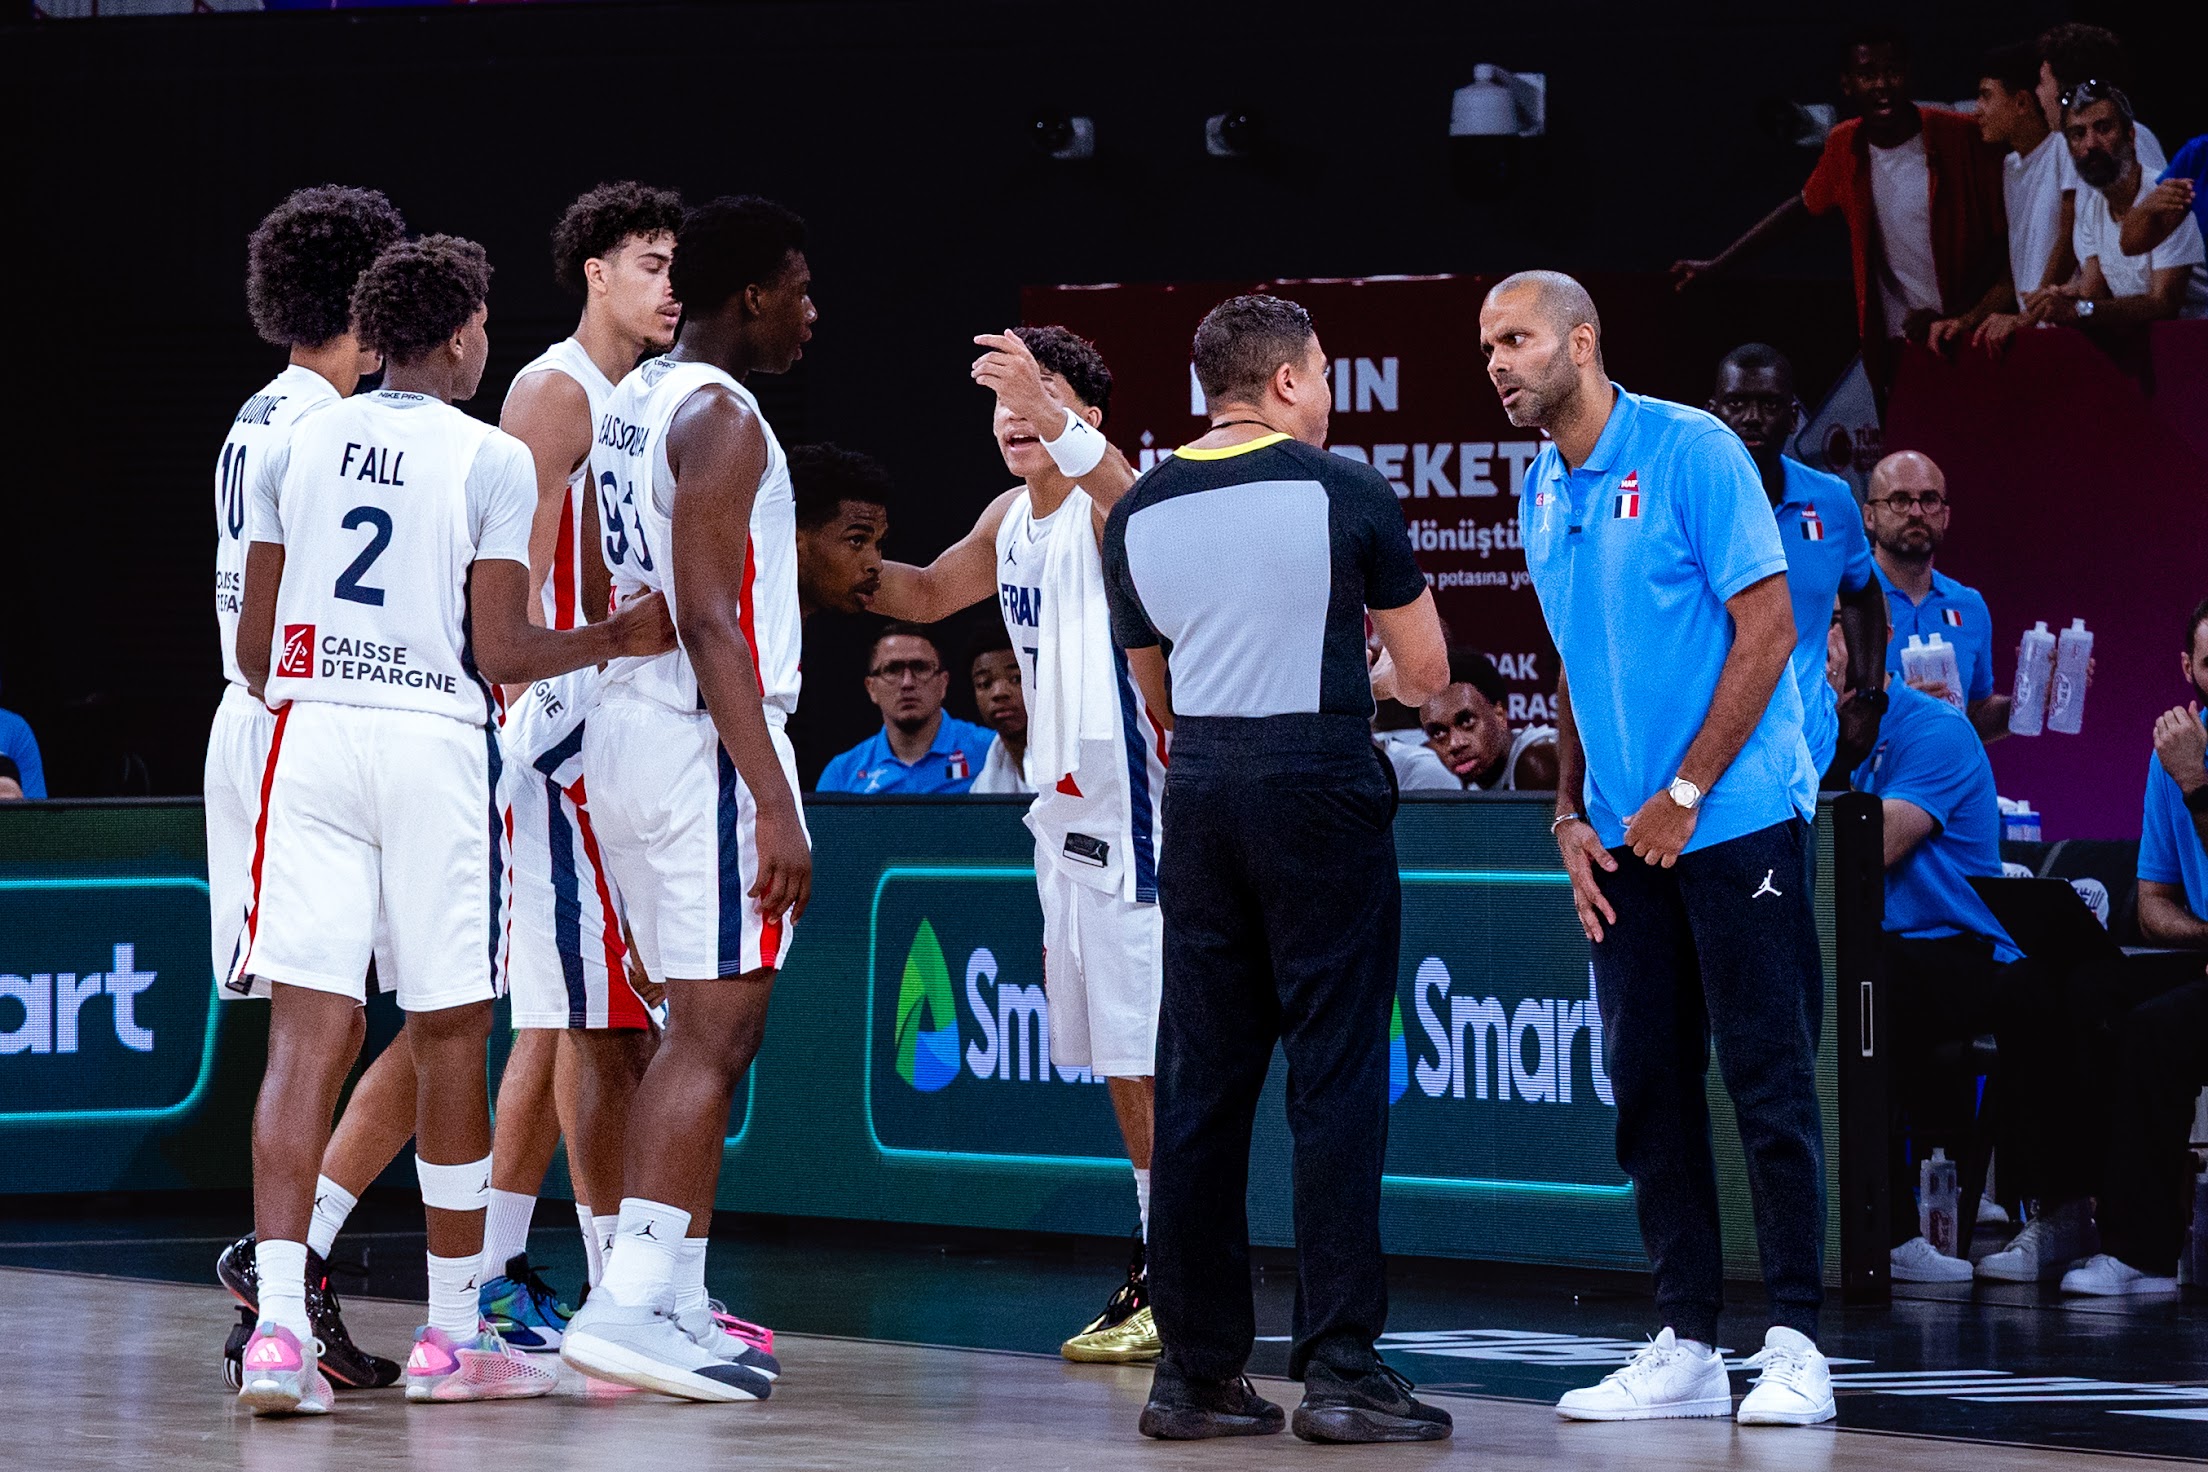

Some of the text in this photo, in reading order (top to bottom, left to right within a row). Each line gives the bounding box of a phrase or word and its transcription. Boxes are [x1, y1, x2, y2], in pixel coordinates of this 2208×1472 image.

[339, 442, 405, 486] FALL
[221, 442, 247, 540] 10
[333, 505, 394, 607] 2
[1407, 518, 1525, 559] dönüştü
[1510, 571, 1533, 591] yo
[1001, 582, 1042, 628] FRAN
[321, 636, 407, 665] CAISSE
[321, 660, 457, 694] D'EPARGNE
[533, 680, 564, 719] GNE
[1414, 956, 1616, 1105] Smart
